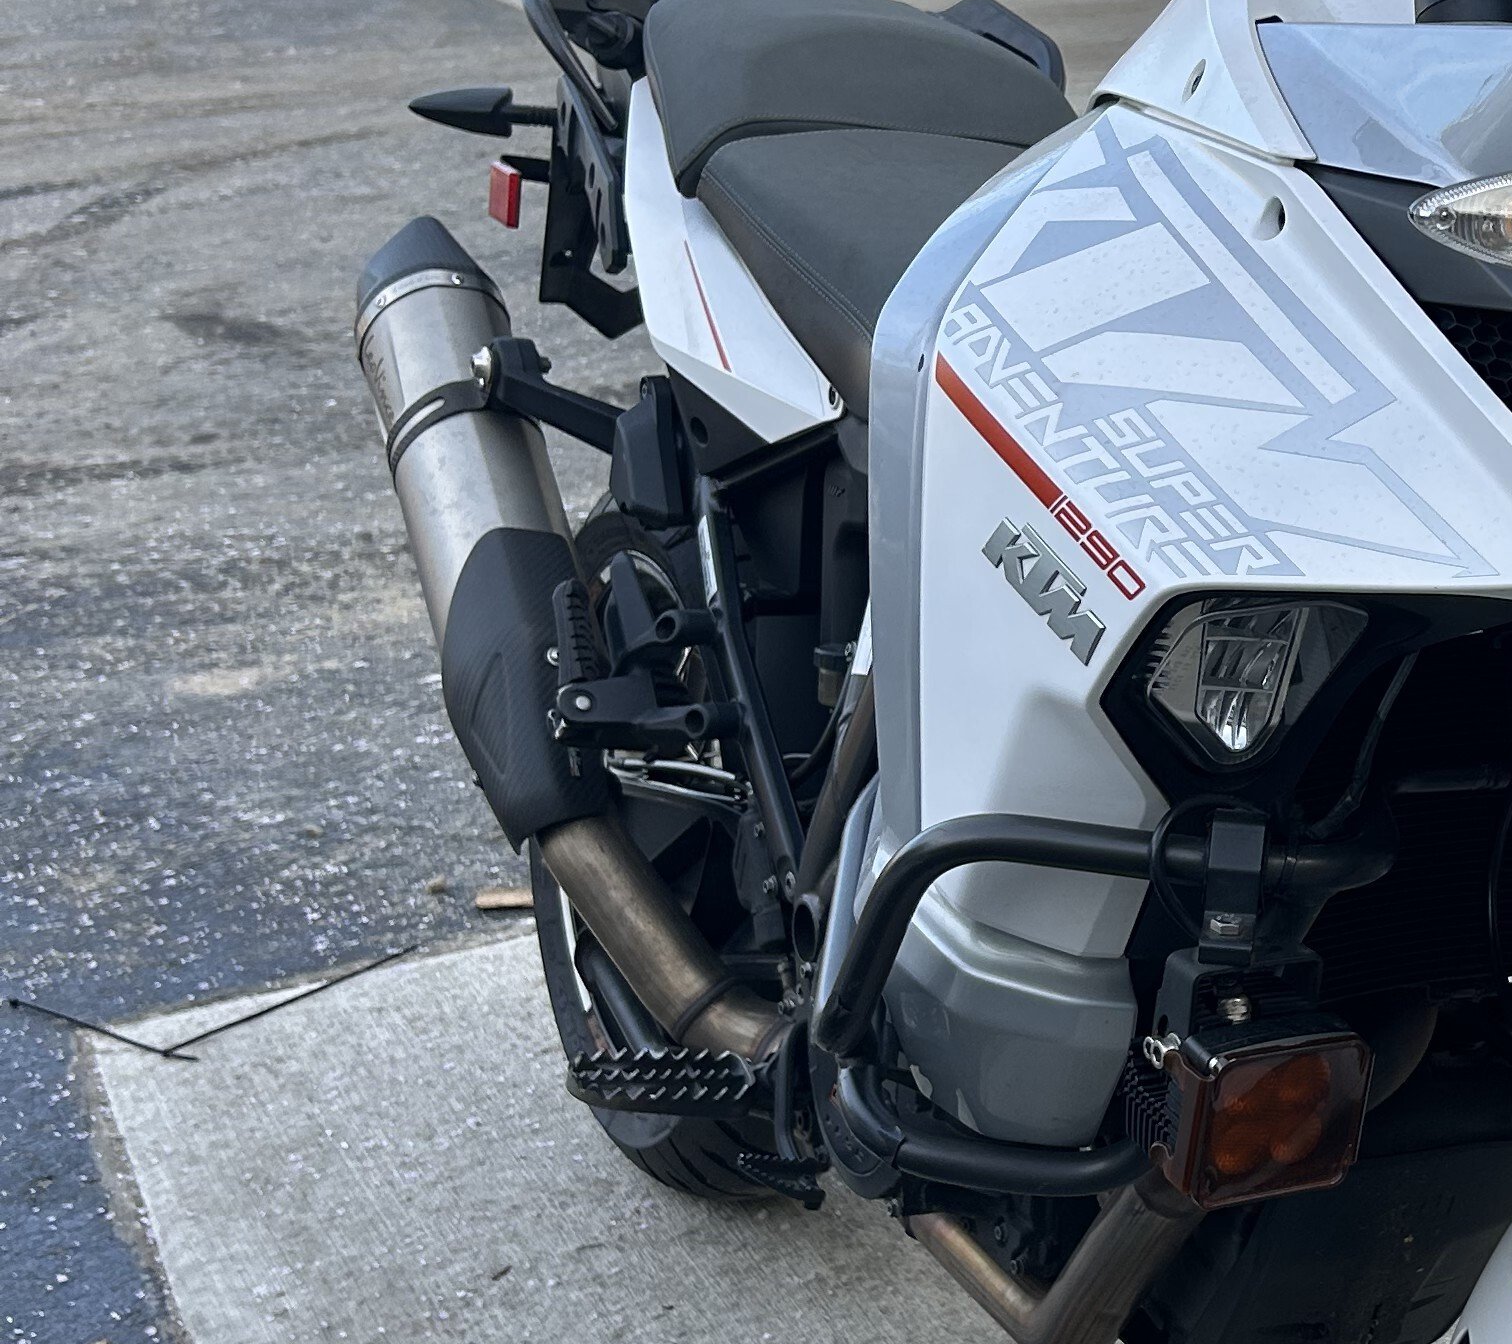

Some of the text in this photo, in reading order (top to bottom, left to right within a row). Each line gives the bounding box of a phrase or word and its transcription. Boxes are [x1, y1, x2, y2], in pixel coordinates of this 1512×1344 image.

[943, 303, 1215, 579] ADVENTURE
[1093, 408, 1280, 576] SUPER
[978, 517, 1106, 666] KTM
[1050, 494, 1147, 601] 1290
